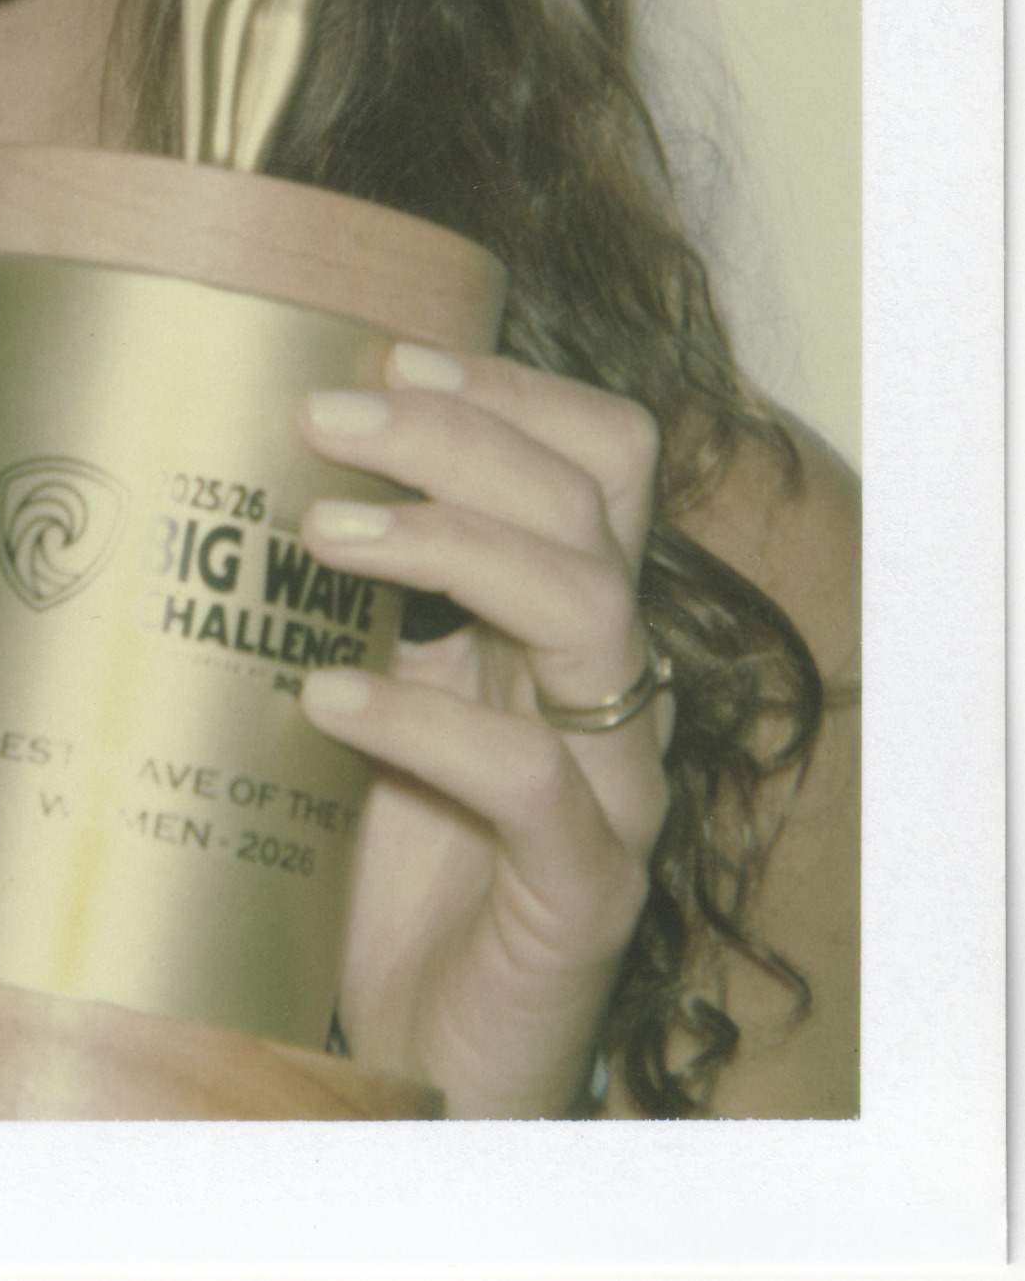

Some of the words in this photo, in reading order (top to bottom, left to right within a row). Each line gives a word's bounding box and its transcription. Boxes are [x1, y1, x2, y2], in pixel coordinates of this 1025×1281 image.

[168, 471, 266, 523] 025/26
[150, 592, 368, 668] HALLENGE
[137, 756, 220, 801] AVE
[228, 775, 280, 810] OF
[289, 788, 340, 833] THE
[39, 790, 213, 851] WMEN
[236, 830, 317, 877] 2026
